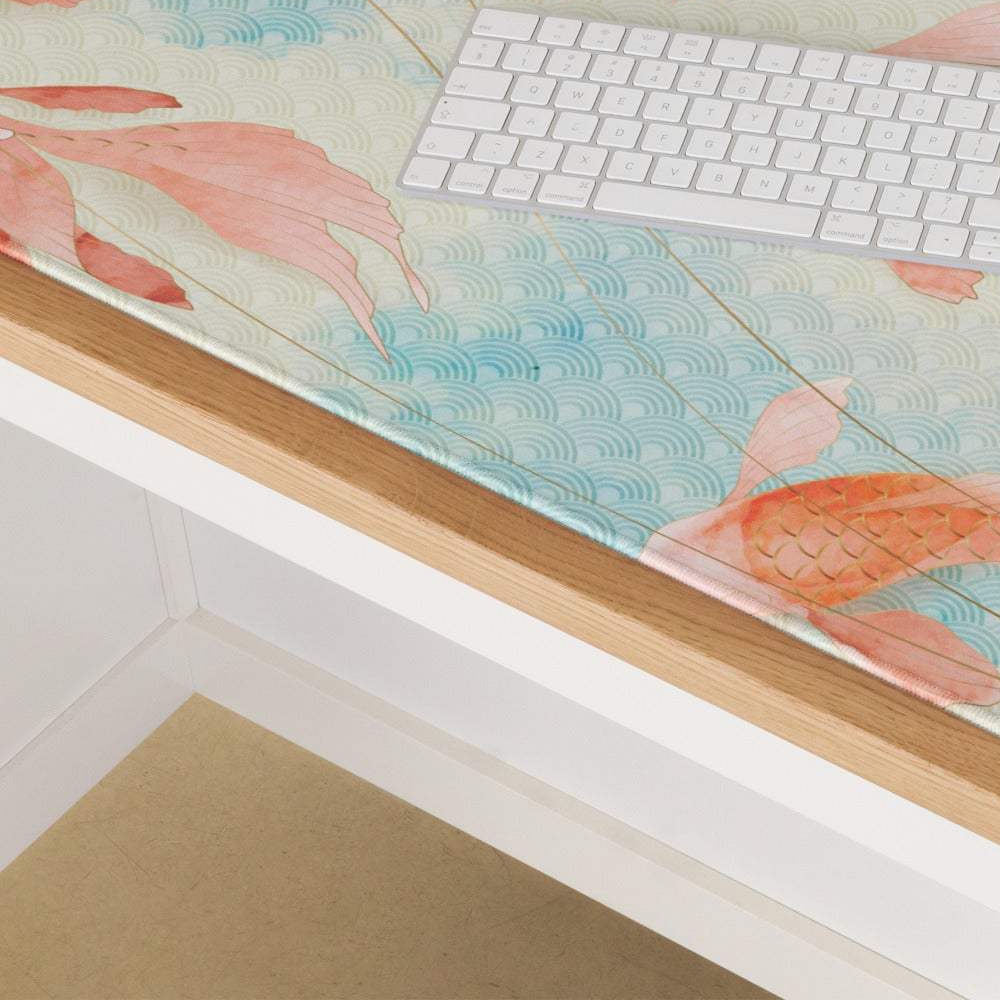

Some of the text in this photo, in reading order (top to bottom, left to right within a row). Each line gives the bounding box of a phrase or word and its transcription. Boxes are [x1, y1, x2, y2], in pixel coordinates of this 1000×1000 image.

[530, 86, 538, 94] Q
[572, 90, 584, 99] W
[617, 97, 625, 105] E
[662, 103, 669, 111] R
[708, 108, 715, 116] T
[752, 113, 759, 121] Y
[795, 120, 804, 128] U
[929, 136, 937, 144] P
[615, 128, 624, 136] D
[660, 134, 668, 142] F
[705, 140, 713, 148] G
[749, 145, 759, 153] H
[839, 157, 847, 165] K
[580, 155, 589, 164] X
[625, 162, 634, 170] C
[671, 167, 679, 176] V
[714, 174, 723, 182] B
[760, 180, 769, 188] N
[804, 185, 815, 193] M
